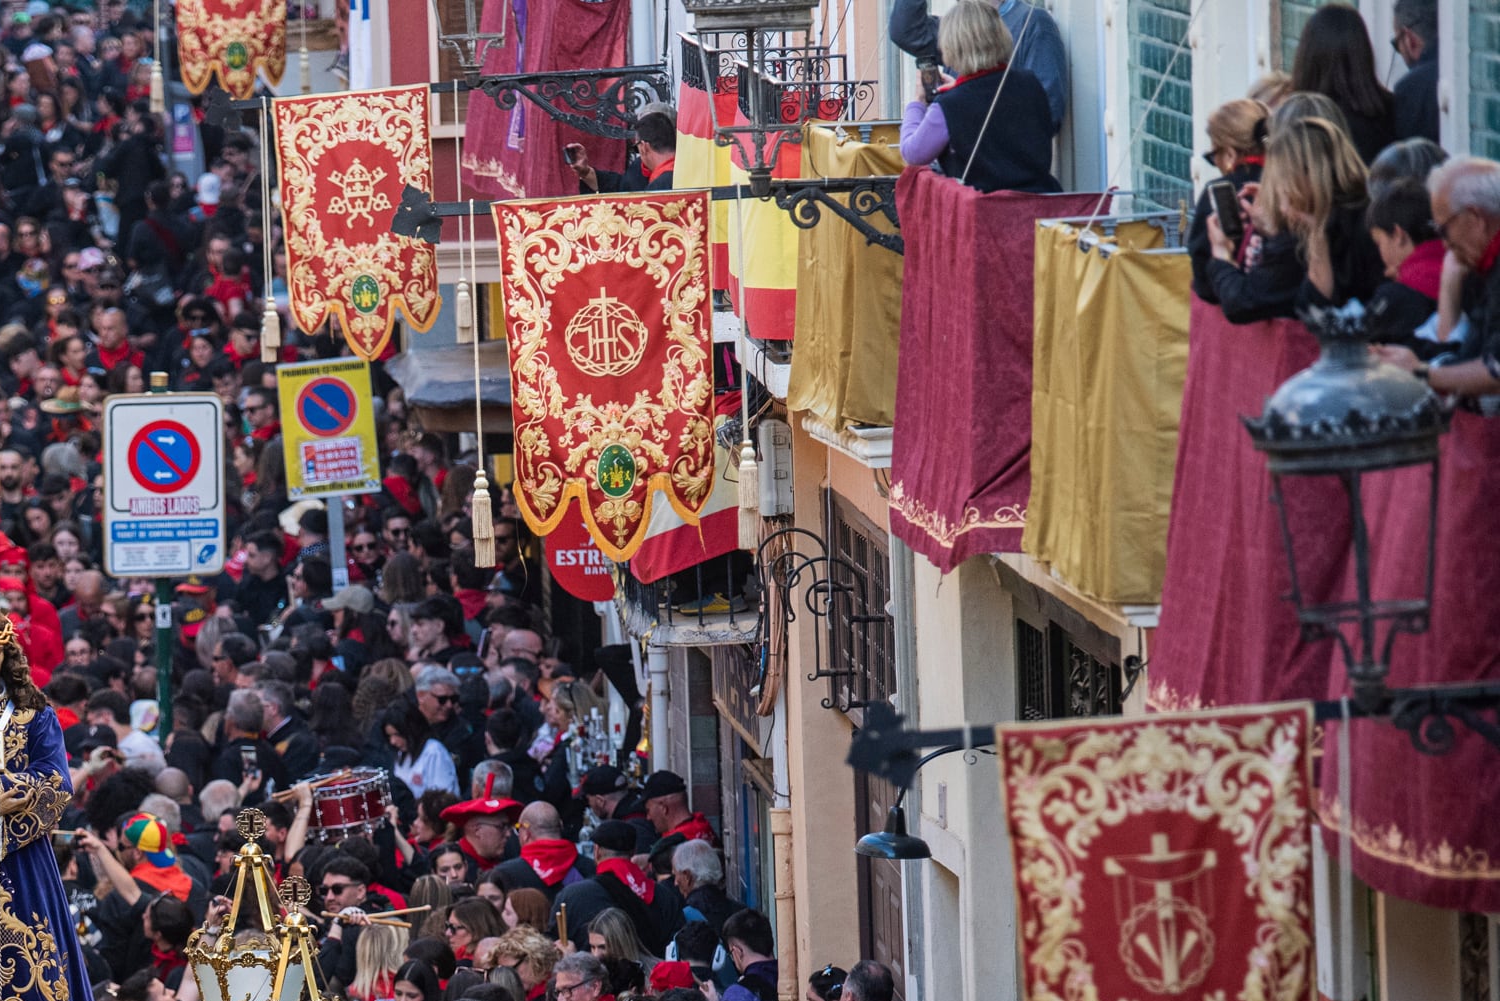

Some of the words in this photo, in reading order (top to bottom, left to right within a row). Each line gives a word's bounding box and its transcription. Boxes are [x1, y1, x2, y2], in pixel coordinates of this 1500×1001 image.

[131, 498, 166, 514] AMBOS
[168, 497, 200, 513] LADOS
[556, 549, 605, 566] ESTR
